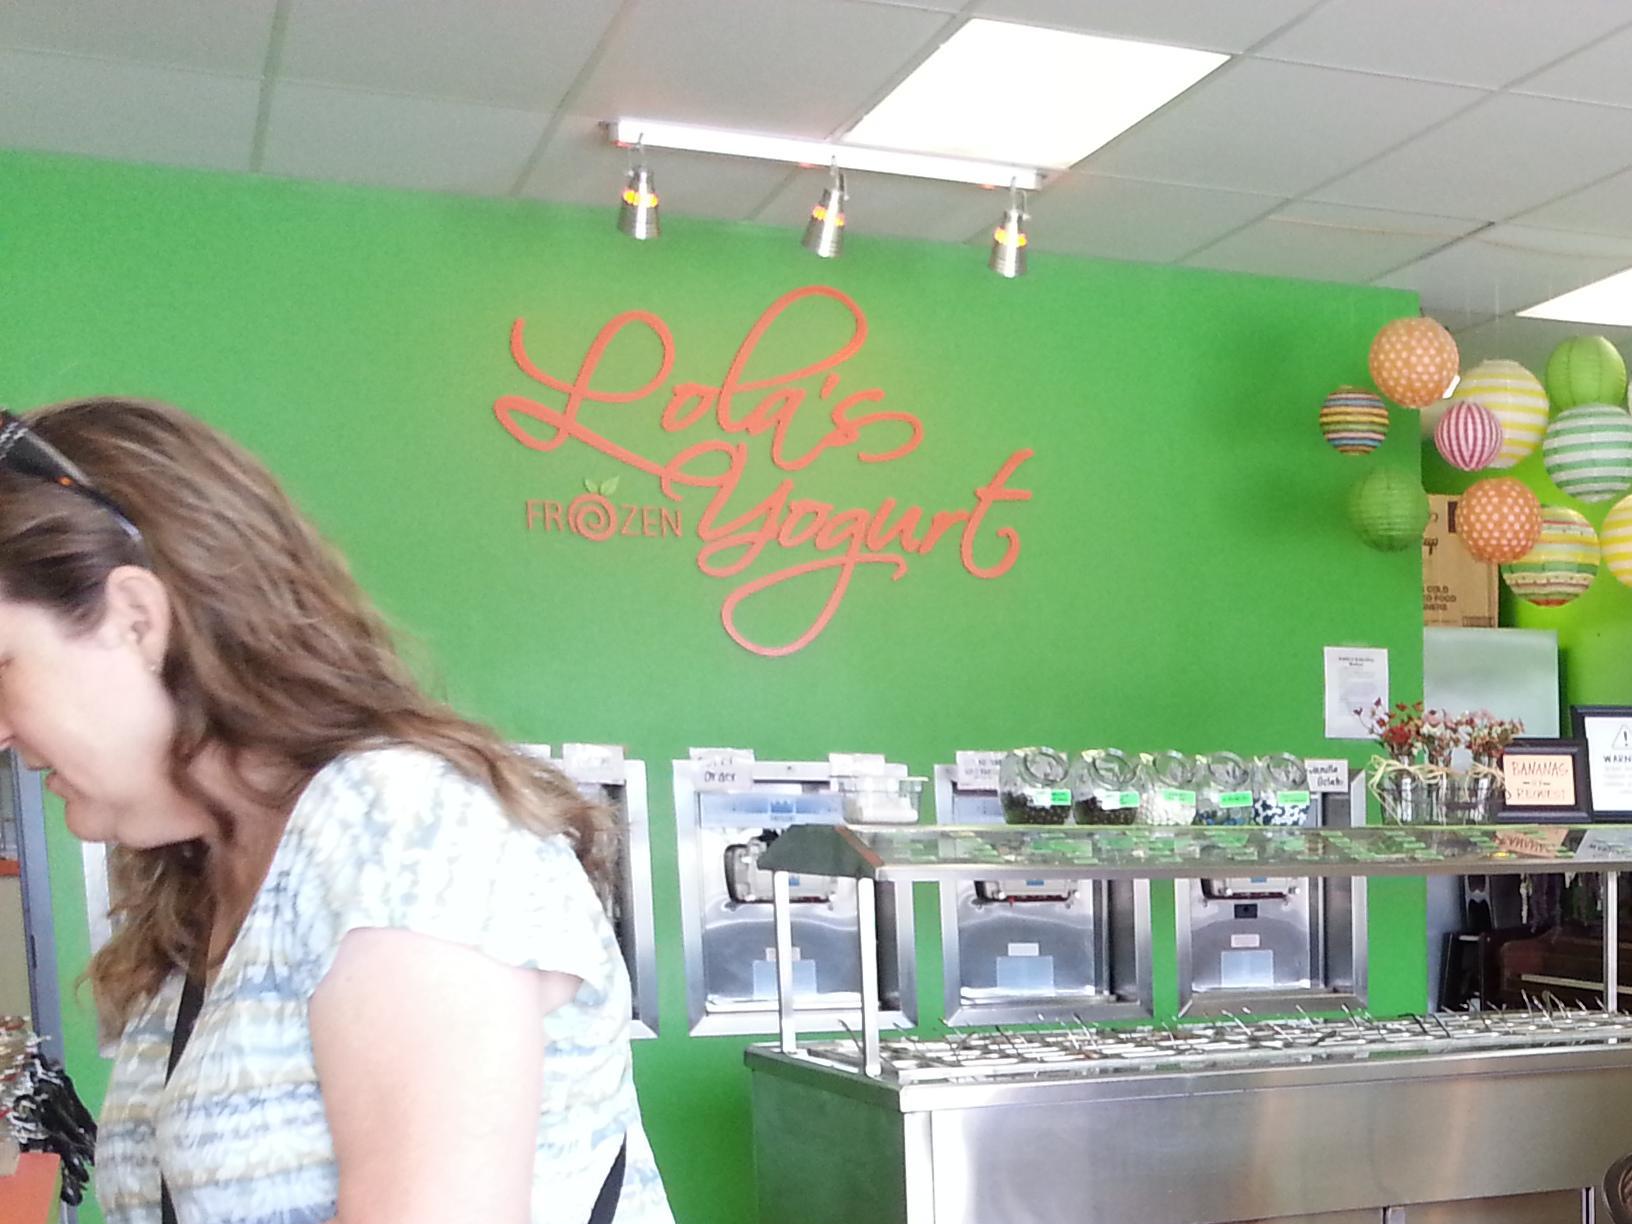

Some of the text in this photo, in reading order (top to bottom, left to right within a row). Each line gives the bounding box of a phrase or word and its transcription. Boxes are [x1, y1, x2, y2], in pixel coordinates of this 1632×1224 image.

[493, 285, 924, 477] Lola's
[525, 491, 684, 541] FROZEN
[661, 440, 1035, 657] Yogurt
[1511, 760, 1569, 776] BANANAS
